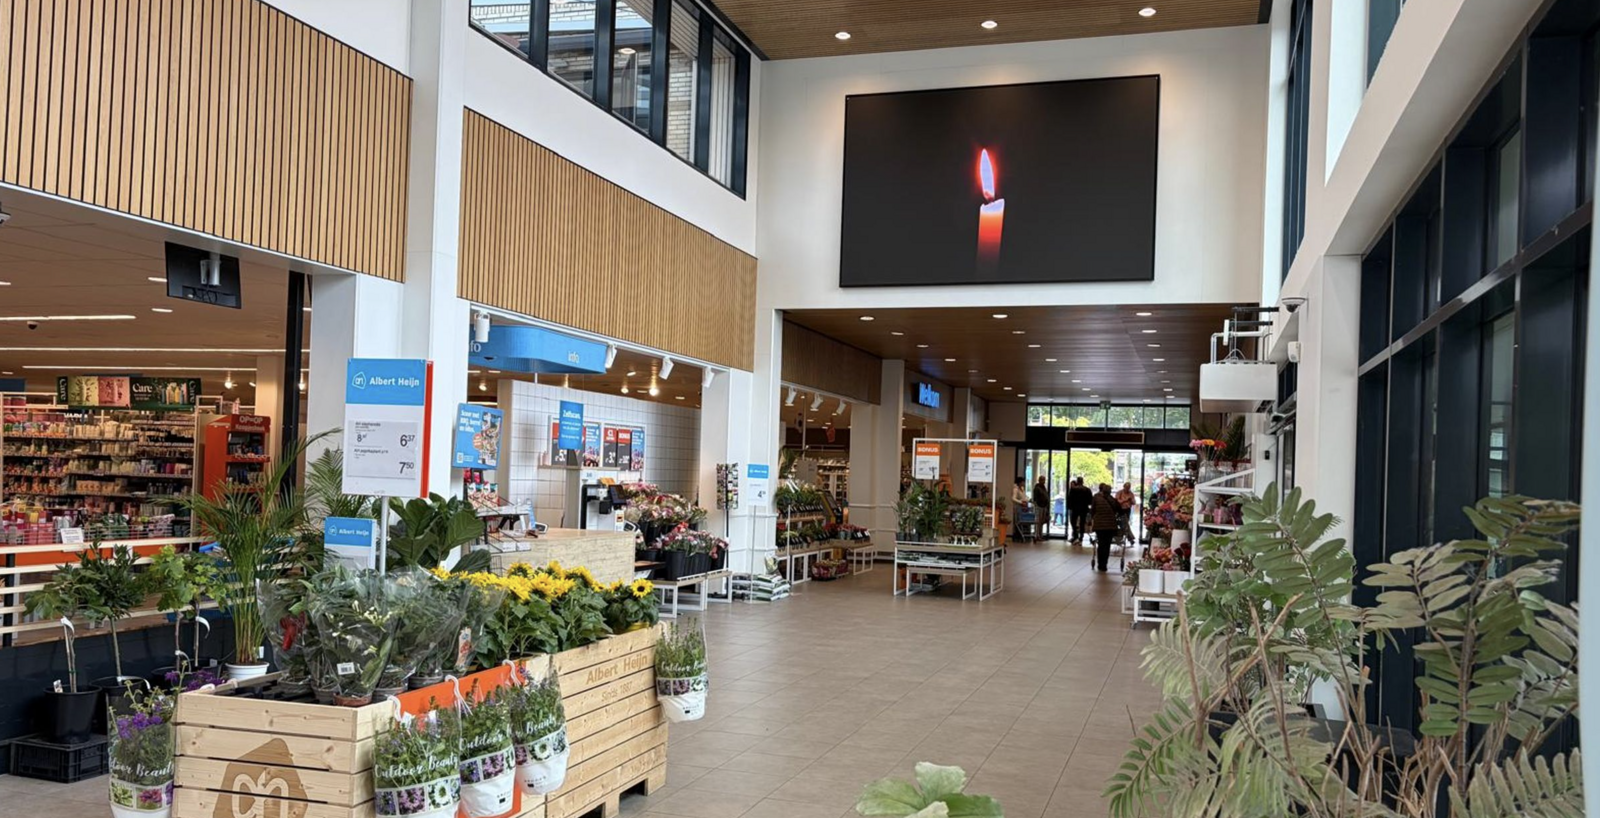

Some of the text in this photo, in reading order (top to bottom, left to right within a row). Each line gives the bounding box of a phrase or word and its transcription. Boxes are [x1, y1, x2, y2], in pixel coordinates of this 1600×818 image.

[470, 340, 481, 352] fo
[568, 351, 579, 364] info
[132, 383, 153, 393] Care
[369, 377, 396, 386] Albert
[398, 378, 420, 388] Heijn
[585, 653, 648, 685] Albert Heijn
[602, 688, 618, 702] Sinds
[526, 714, 557, 734] Beauty
[459, 730, 503, 752] Outdoor
[374, 752, 458, 778] Outdoor Beauty
